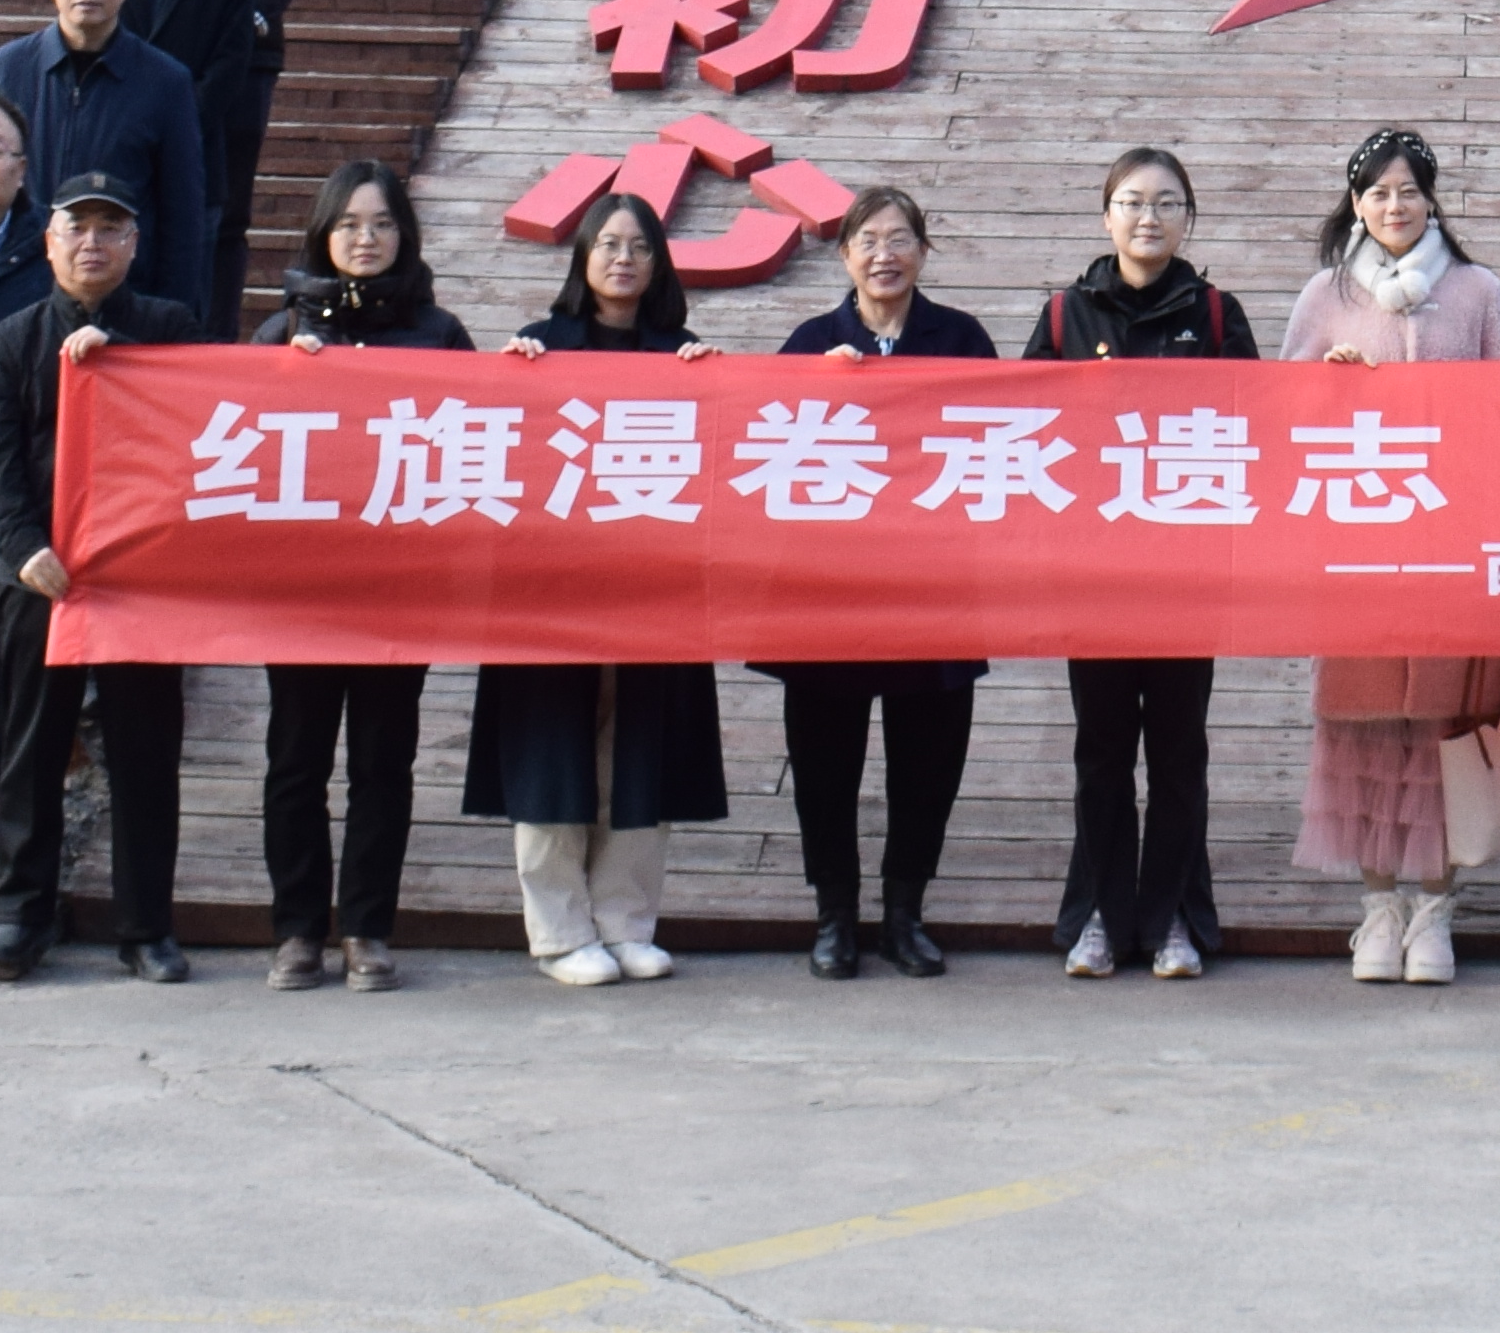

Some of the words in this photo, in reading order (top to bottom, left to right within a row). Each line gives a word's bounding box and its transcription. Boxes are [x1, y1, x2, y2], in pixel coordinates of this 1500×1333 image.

[184, 396, 1450, 527] 红旗漫卷承遗志
